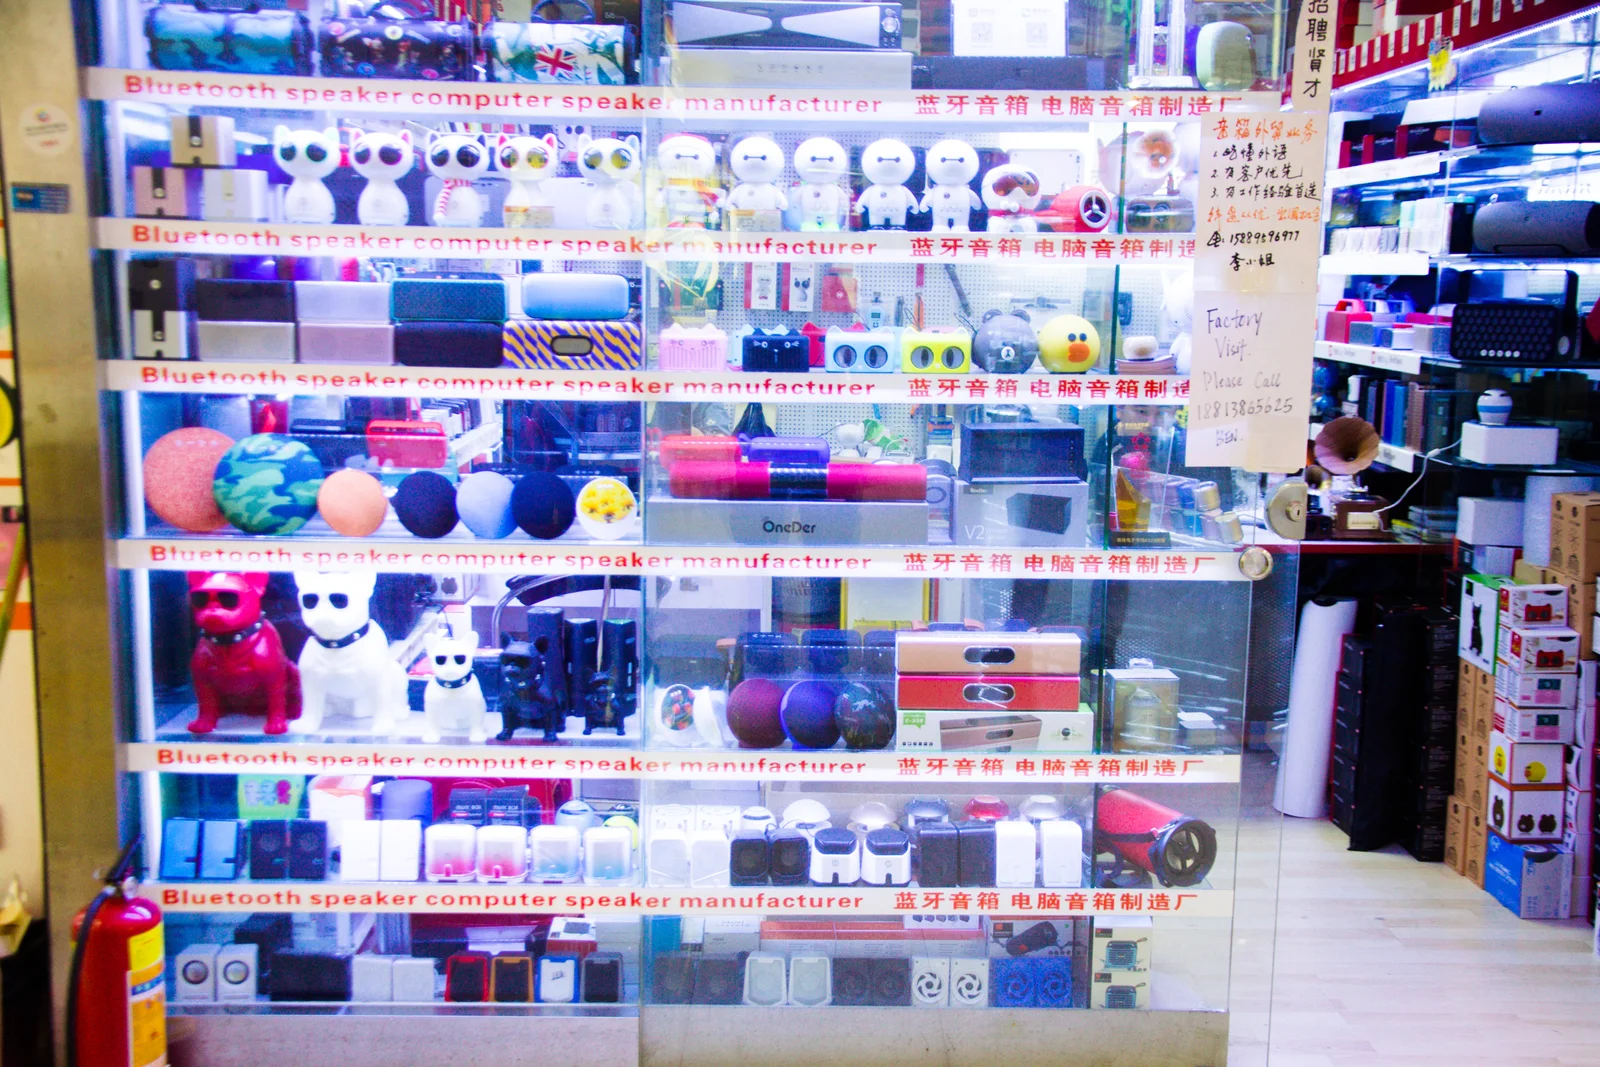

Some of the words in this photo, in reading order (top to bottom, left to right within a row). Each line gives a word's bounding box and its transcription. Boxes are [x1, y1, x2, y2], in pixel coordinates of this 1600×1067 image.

[124, 74, 276, 99] Bluetooth
[285, 85, 404, 103] speaker
[411, 91, 553, 111] computer
[561, 92, 671, 112] speaker
[685, 94, 882, 112] manufacturer
[916, 94, 1030, 115] 蓝牙音箱
[1041, 94, 1243, 117] 电脑音箱制造厂
[131, 224, 281, 247] Bluetooth
[289, 231, 405, 250] speaker
[413, 236, 553, 253] computer
[561, 236, 673, 255] speaker
[683, 237, 877, 255] manufacturer
[909, 236, 1023, 258] 蓝牙音箱
[1207, 308, 1263, 336] Factory
[142, 366, 287, 384] Bluetooth
[296, 372, 410, 389] speaker
[417, 376, 555, 394] computer
[563, 376, 675, 395] speaker
[682, 377, 876, 396] manufacturer
[906, 377, 1019, 398] 蓝牙音箱
[1203, 371, 1243, 391] Please
[1253, 371, 1281, 389] Call
[761, 517, 817, 533] OneDer
[964, 525, 985, 540] V2
[150, 545, 291, 562] Bluetooth
[302, 548, 414, 565] speaker
[421, 551, 556, 568] computer
[564, 551, 672, 570] speaker
[681, 552, 872, 569] manufacturer
[905, 553, 1013, 574] 蓝牙音箱
[1023, 553, 1216, 575] 电脑音箱制造厂
[156, 747, 297, 766] Bluetooth
[306, 753, 415, 768] speaker
[423, 756, 556, 773] computer
[564, 756, 671, 773] speaker
[680, 757, 866, 774] manufacturer
[897, 757, 1005, 776] 蓝牙音箱
[1015, 757, 1205, 777] 电脑音箱制造厂
[162, 889, 302, 906] Bluetooth
[310, 891, 418, 909] speaker
[425, 892, 557, 909] computer
[564, 892, 671, 910] speaker
[679, 892, 864, 909] manufacturer
[894, 892, 1001, 911] 蓝牙音箱
[1010, 892, 1199, 911] 电脑音箱制造厂
